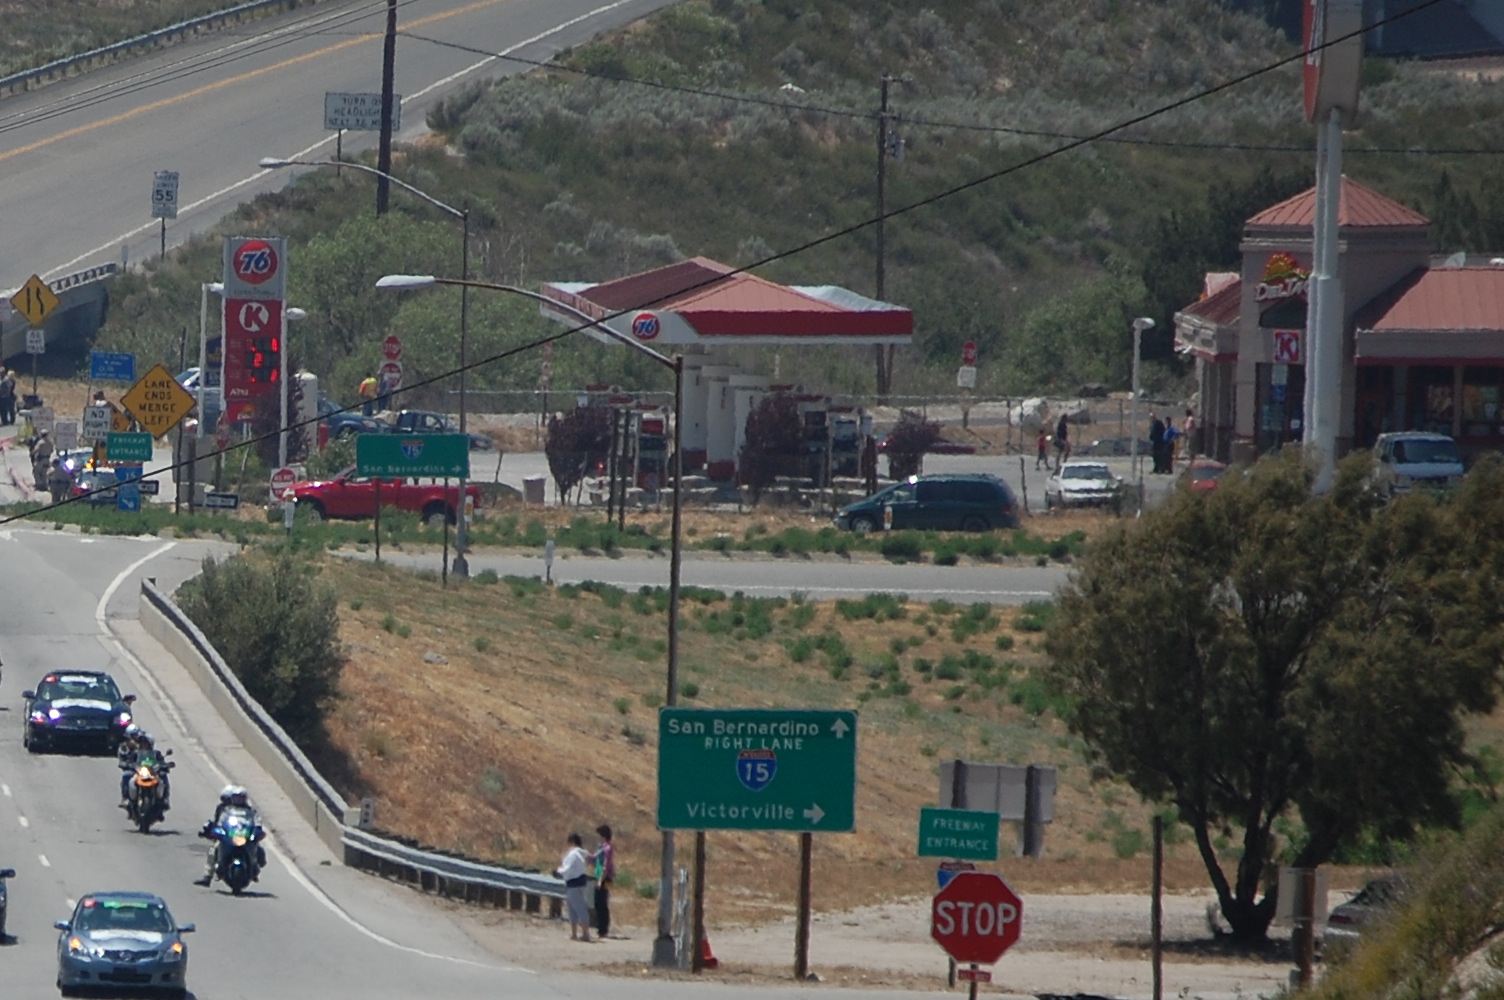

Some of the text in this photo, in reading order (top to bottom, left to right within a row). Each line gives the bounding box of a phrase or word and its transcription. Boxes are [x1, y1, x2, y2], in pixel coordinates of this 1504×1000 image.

[343, 97, 366, 106] TURN
[155, 189, 174, 201] 55
[239, 247, 271, 274] 76
[634, 318, 656, 336] 76
[144, 380, 171, 389] LANE
[144, 391, 172, 400] ENDS
[139, 403, 176, 412] MERGE
[91, 410, 105, 419] NO
[144, 415, 170, 425] LEFT
[363, 465, 383, 474] San
[668, 718, 819, 736] San Bernardino
[704, 737, 804, 750] RIGHT LANE
[746, 763, 770, 782] 15
[686, 803, 794, 820] Victorville
[933, 818, 986, 832] FREEWAY
[926, 837, 989, 851] ENTRANCE
[936, 900, 1017, 937] STOP
